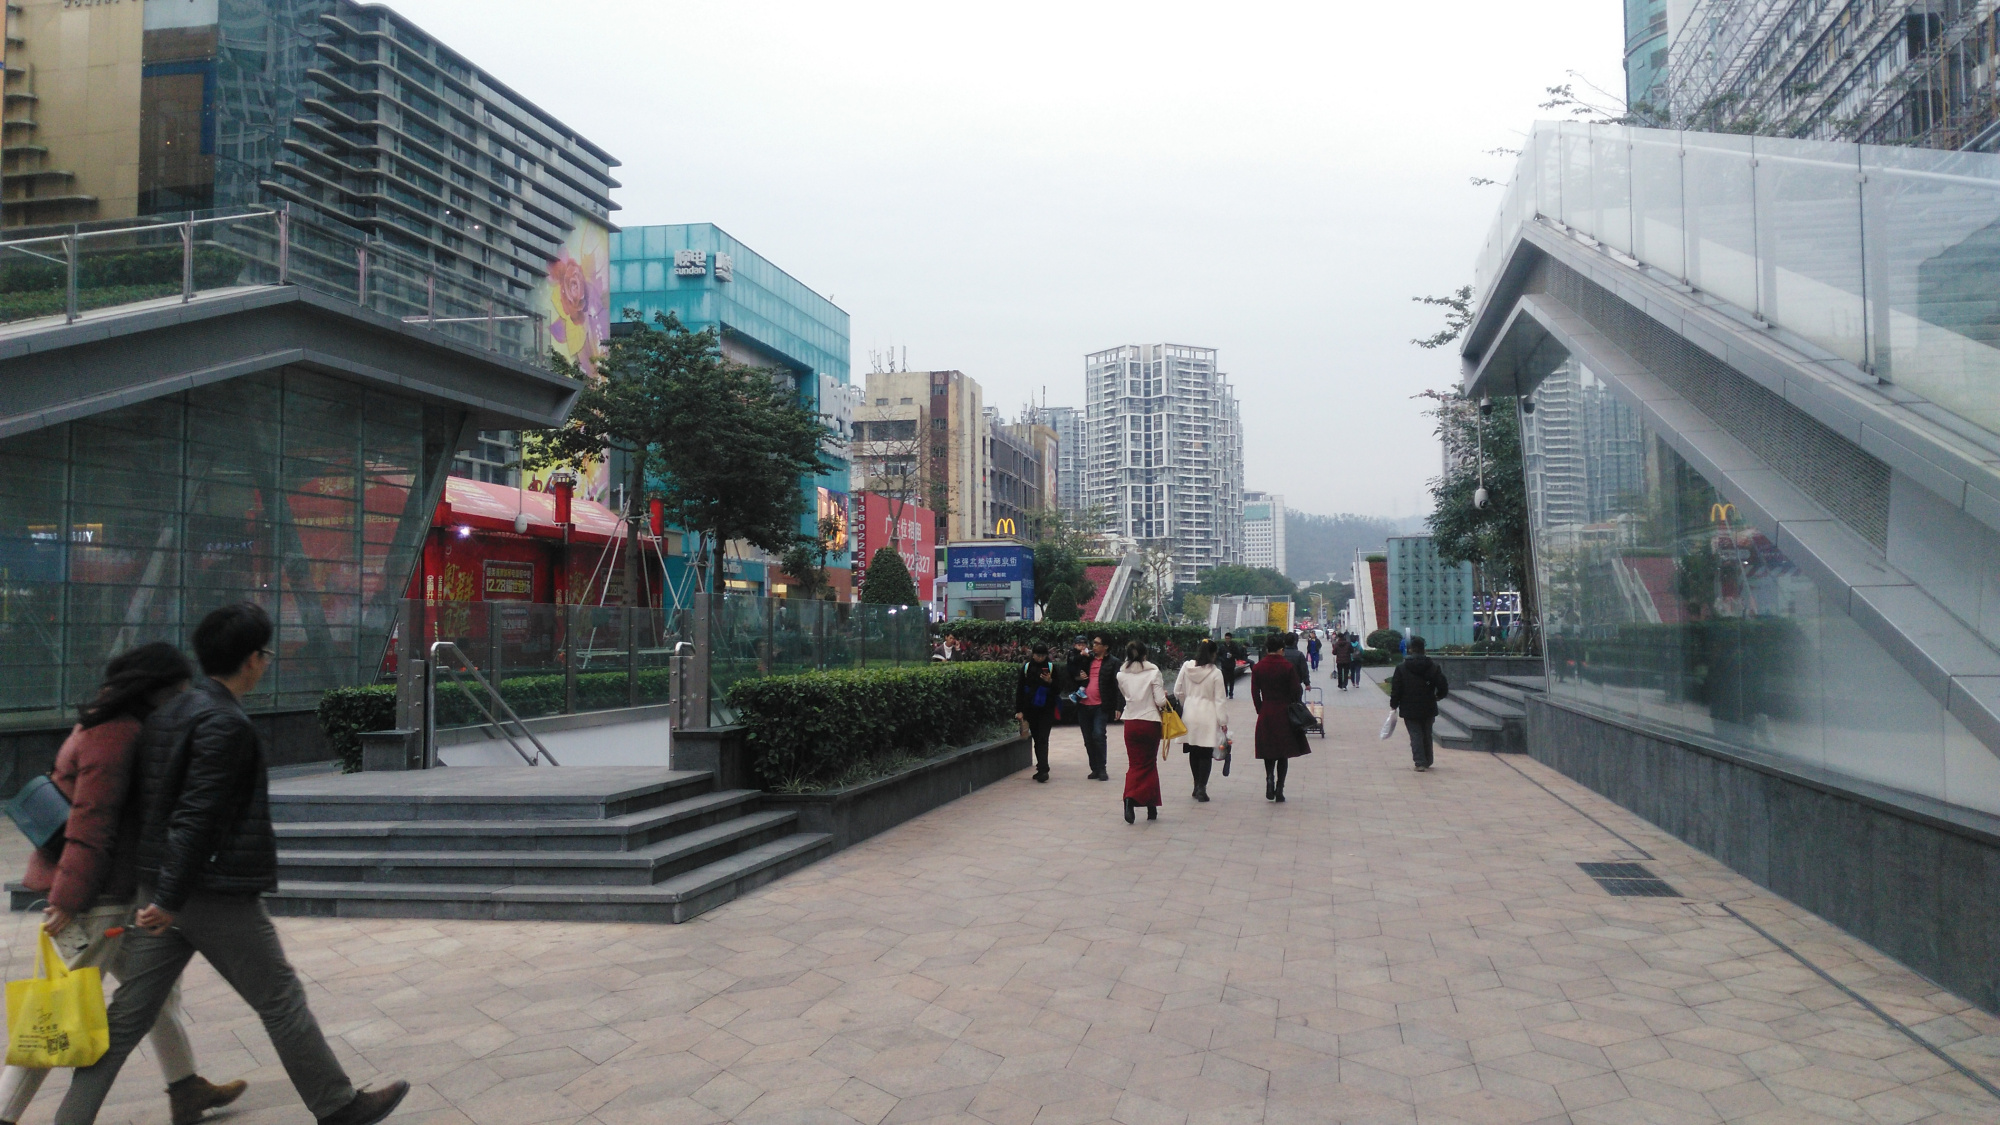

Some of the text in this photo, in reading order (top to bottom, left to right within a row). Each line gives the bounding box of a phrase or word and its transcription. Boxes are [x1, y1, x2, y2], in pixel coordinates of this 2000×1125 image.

[953, 557, 1017, 566] 华强北地铁商业街
